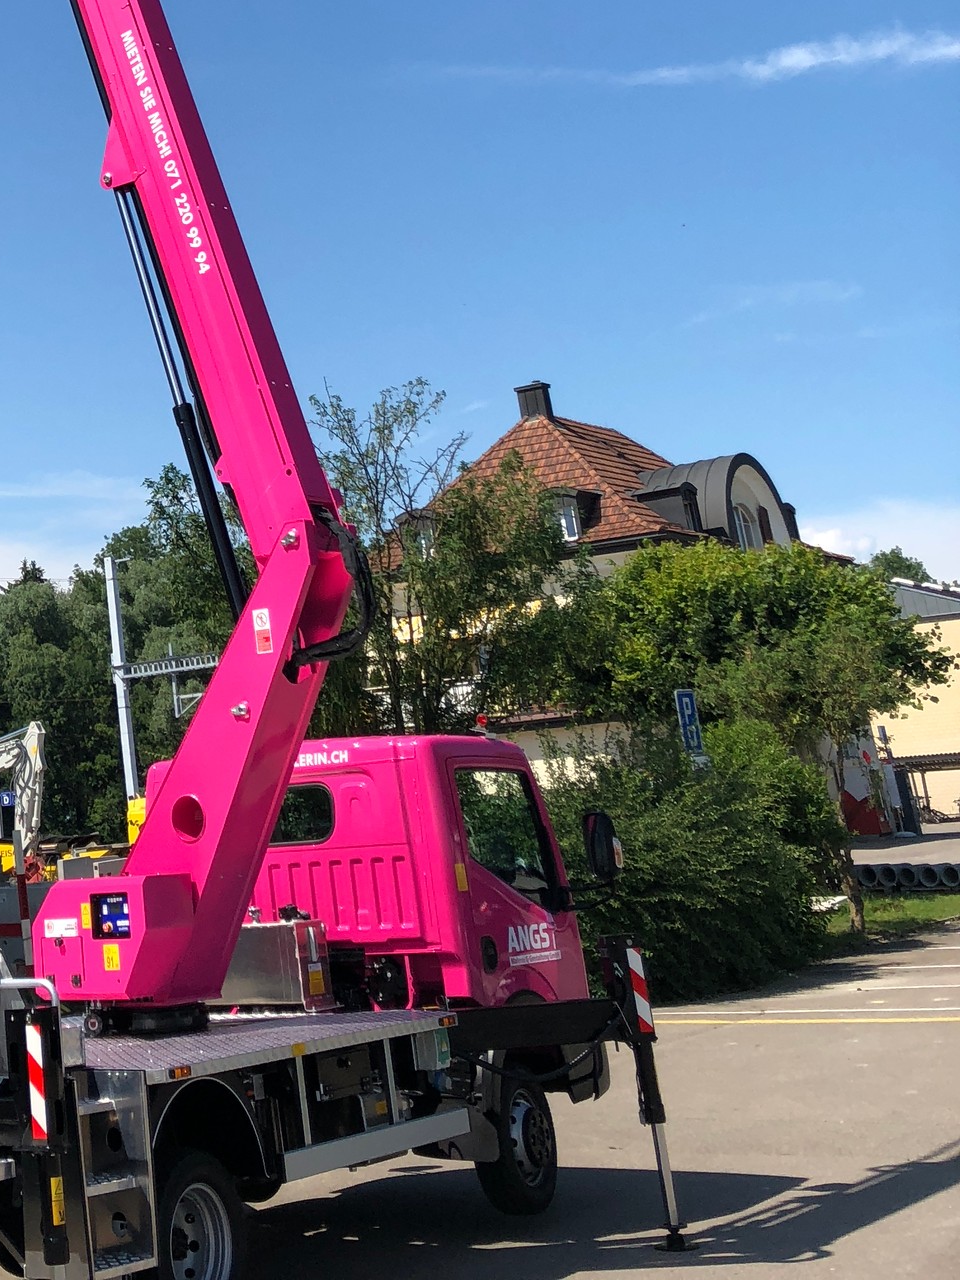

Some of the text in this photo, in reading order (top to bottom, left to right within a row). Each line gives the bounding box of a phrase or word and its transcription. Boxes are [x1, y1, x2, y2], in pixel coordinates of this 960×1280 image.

[121, 30, 210, 274] MIETEN SIE MICH! 071 220 99 94
[3, 796, 10, 805] D
[106, 956, 115, 969] 91
